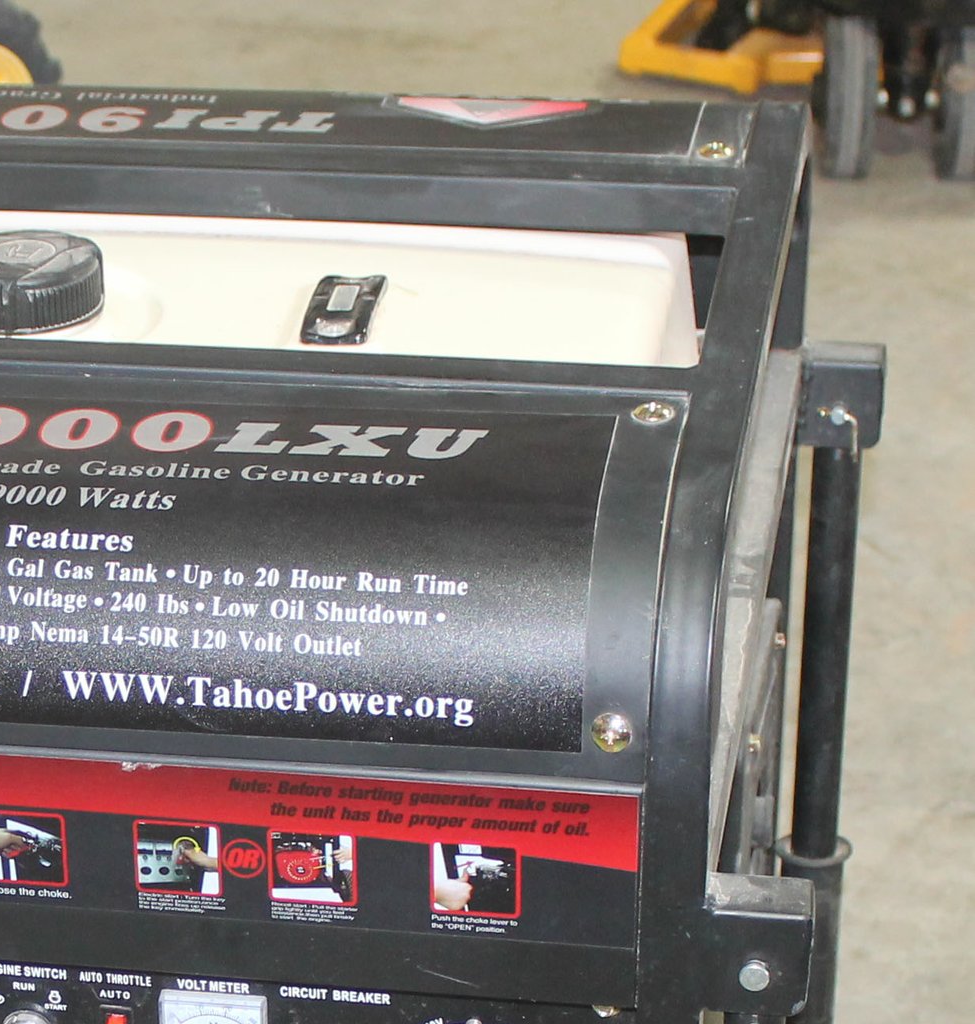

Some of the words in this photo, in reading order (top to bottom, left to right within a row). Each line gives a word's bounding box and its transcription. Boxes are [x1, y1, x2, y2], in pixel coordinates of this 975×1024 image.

[79, 459, 232, 480] Gasoline
[240, 464, 426, 487] Generator
[77, 486, 178, 512] Watts
[5, 523, 134, 553] Features
[7, 556, 44, 579] Gal
[53, 558, 94, 581] Gas
[104, 561, 158, 584] Tank
[182, 564, 214, 590] Up
[223, 567, 245, 587] to
[253, 567, 280, 588] 20
[289, 569, 347, 592] Hour
[357, 571, 402, 594] Run
[412, 573, 469, 597] Time
[7, 585, 88, 613] Voltage
[109, 591, 147, 613] 240
[210, 596, 260, 618] Low
[269, 597, 305, 621] Oil
[314, 601, 428, 627] Shutdown
[62, 670, 475, 728] WWW.TahoePower.org
[228, 778, 272, 794] Note:
[277, 780, 333, 798] Before
[337, 785, 404, 806] starting
[408, 791, 494, 811] generator
[498, 795, 546, 812] make
[551, 801, 591, 815] sure
[270, 802, 298, 818] the
[302, 804, 336, 820] unit
[340, 806, 372, 822] has
[376, 808, 404, 825] the
[408, 812, 467, 832] proper
[471, 817, 537, 835] amount
[541, 820, 561, 836] of
[564, 821, 590, 837] oil.
[226, 850, 259, 869] OR
[18, 886, 36, 898] the
[37, 887, 73, 900] choke.
[24, 965, 67, 981] SWITCH
[79, 970, 103, 984] AUTO
[106, 972, 152, 987] THROTTLE
[12, 981, 36, 992] RUN
[99, 989, 131, 1000] AUTO
[176, 978, 207, 991] VOLT
[209, 979, 250, 994] METER
[279, 986, 328, 1001] CIRCUIT
[332, 990, 391, 1006] BREAKER
[44, 1003, 68, 1012] START
